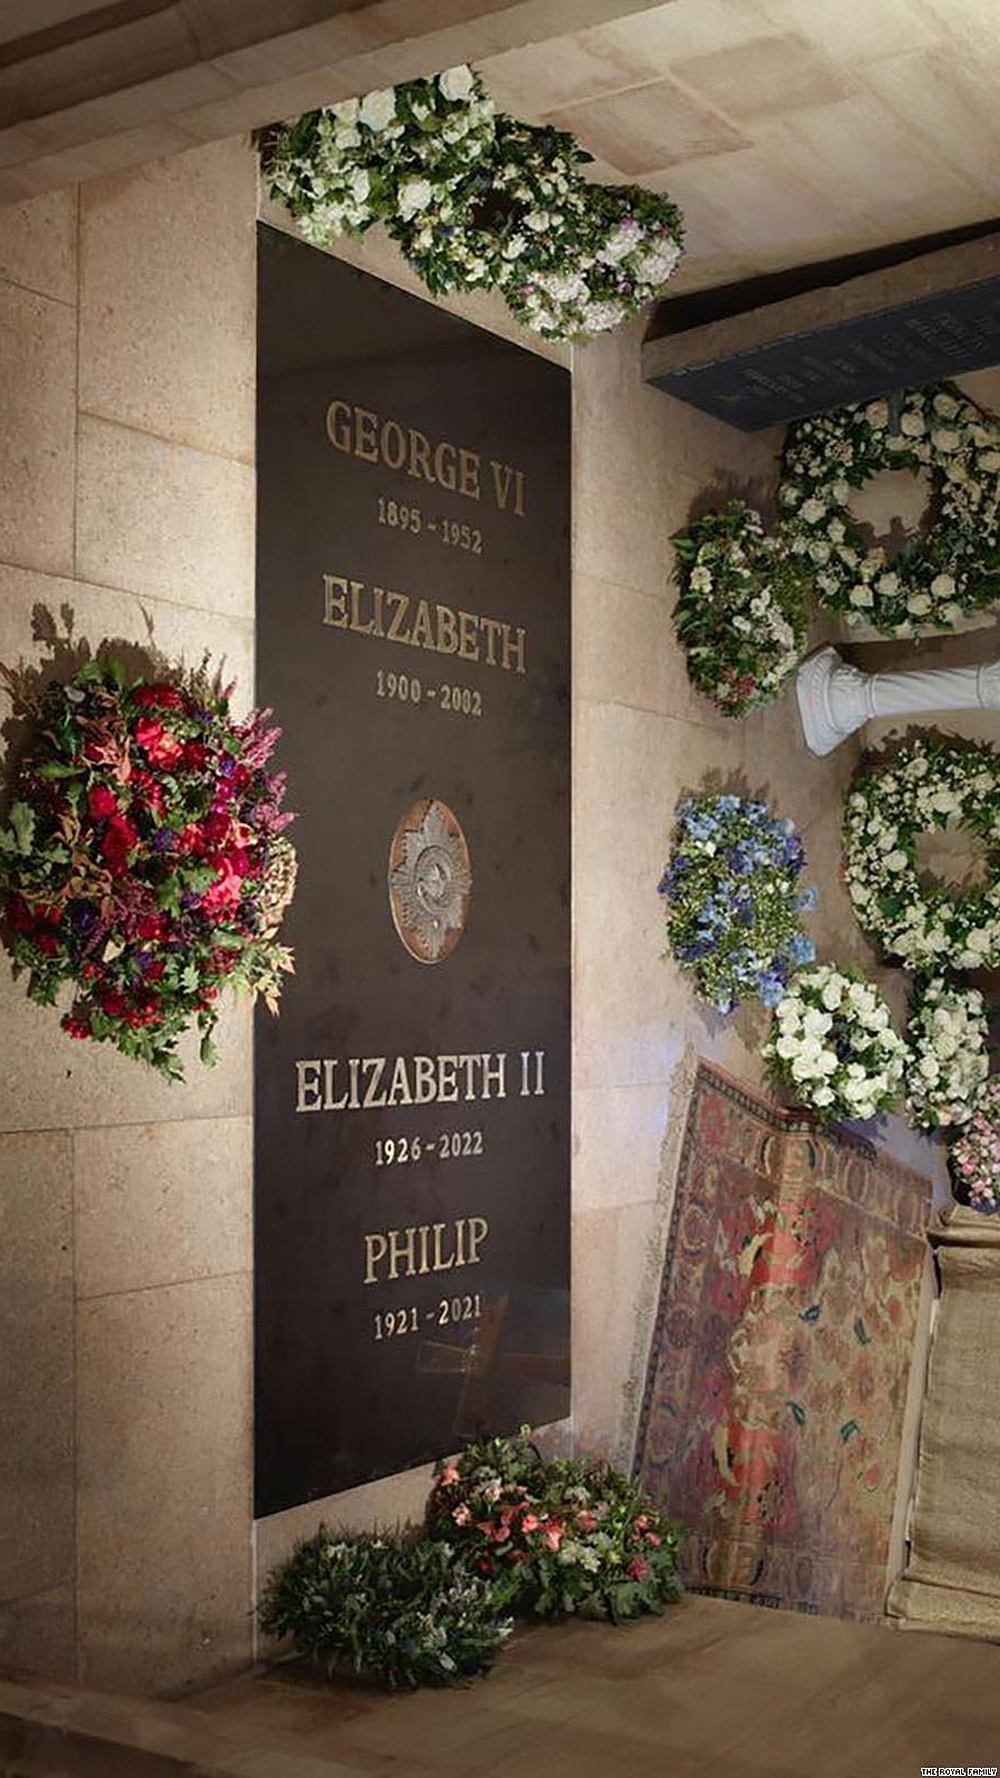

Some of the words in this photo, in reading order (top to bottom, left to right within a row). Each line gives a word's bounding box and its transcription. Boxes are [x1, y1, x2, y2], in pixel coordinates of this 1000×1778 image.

[325, 400, 481, 501] GEORGE
[490, 461, 528, 517] VI
[322, 573, 528, 675] ELIZABETH
[294, 1052, 507, 1113] ELIZABETH
[520, 1050, 546, 1096] II
[363, 1217, 489, 1285] PHILIP
